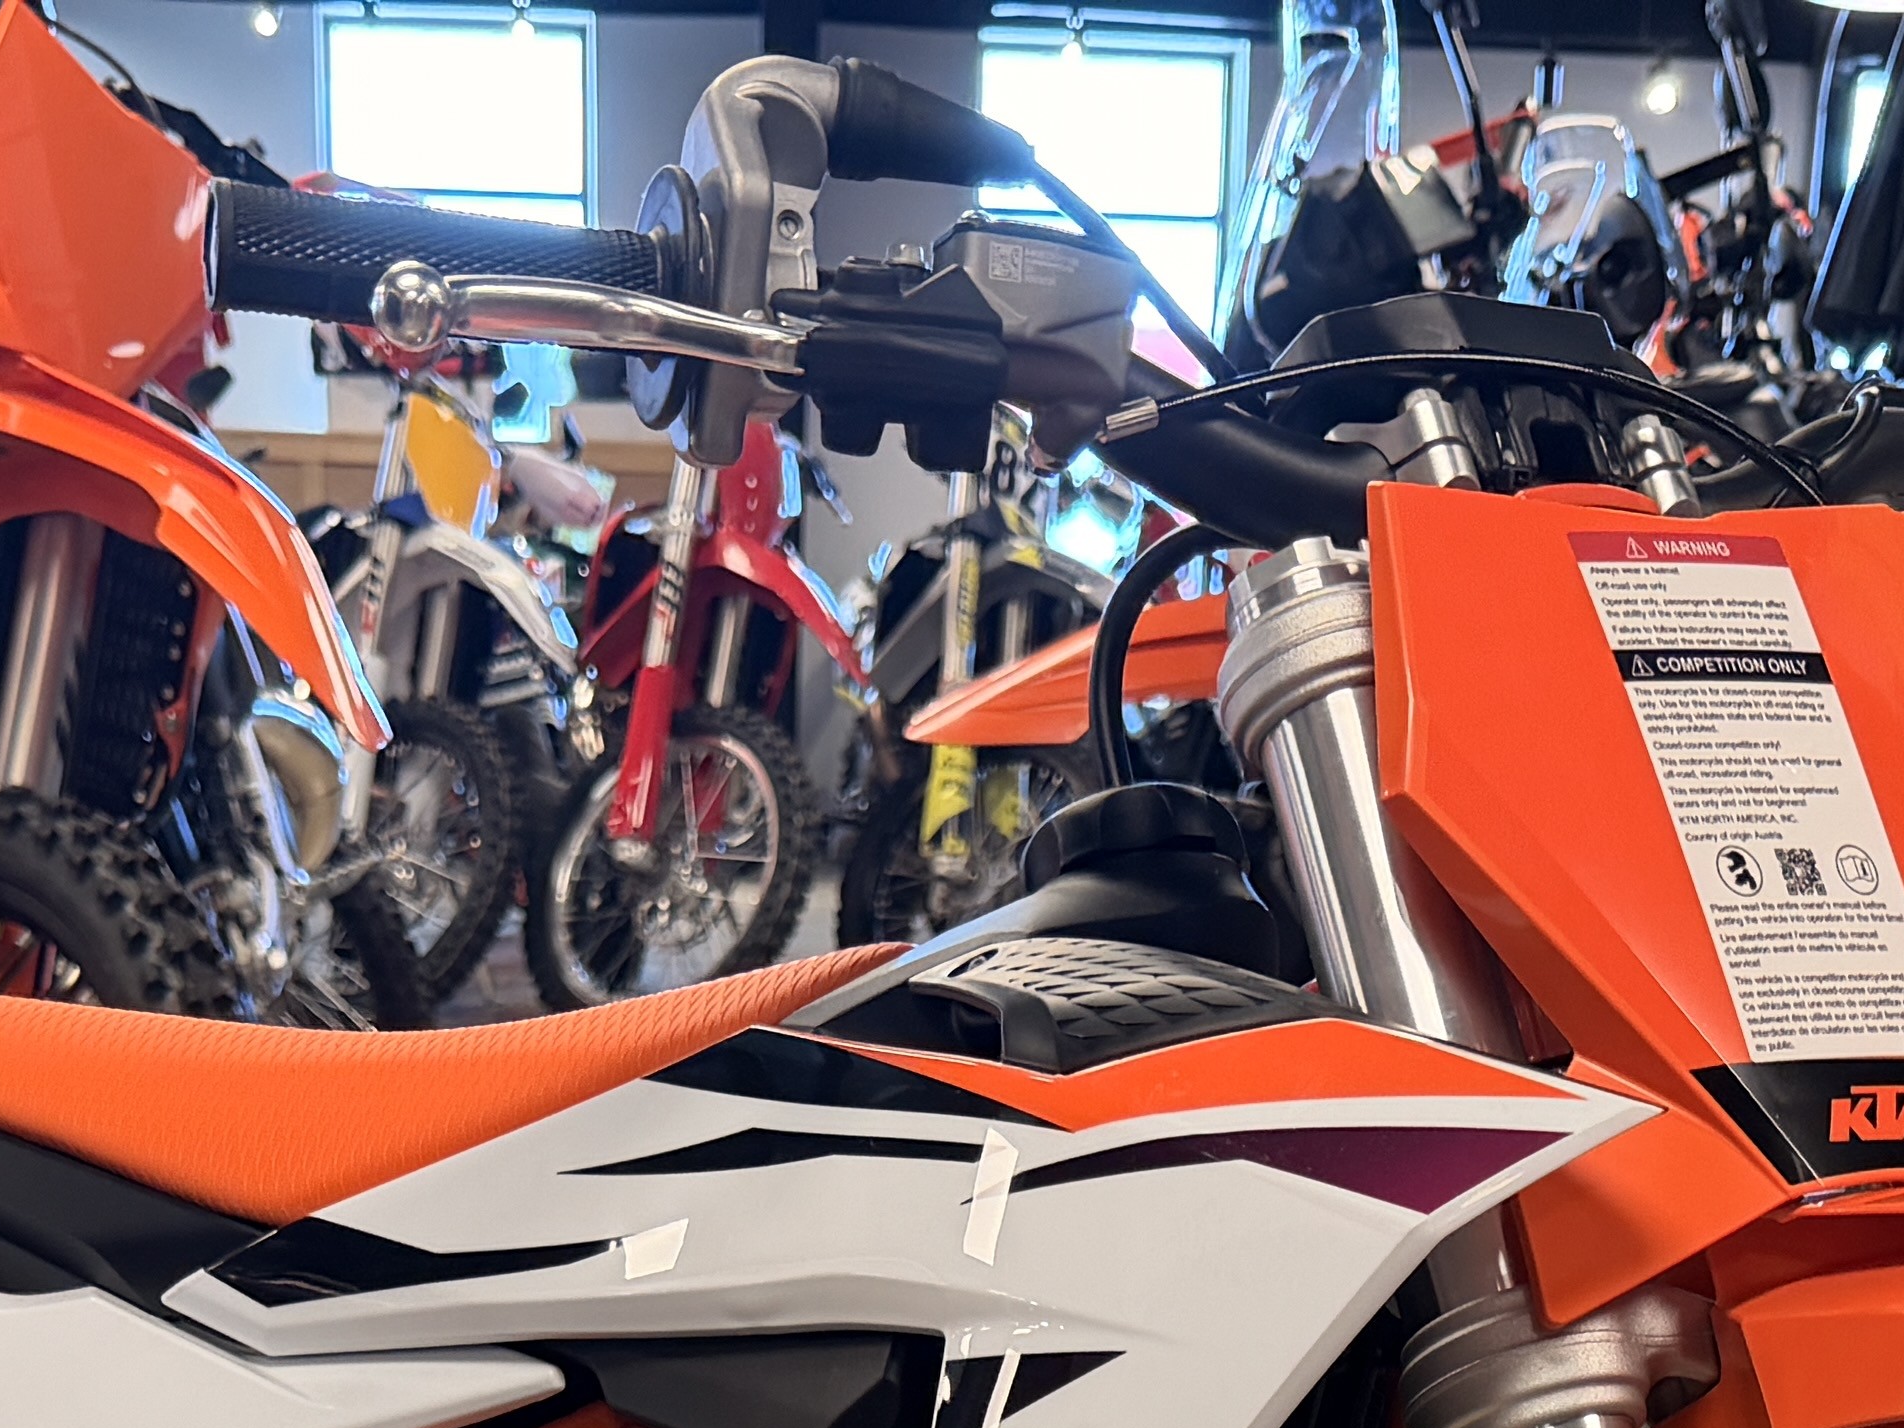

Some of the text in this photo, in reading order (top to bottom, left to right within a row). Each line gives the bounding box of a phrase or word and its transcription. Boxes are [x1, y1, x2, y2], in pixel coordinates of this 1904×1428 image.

[1653, 540, 1731, 557] WARNING
[1656, 656, 1808, 675] COMPETITION ONLY
